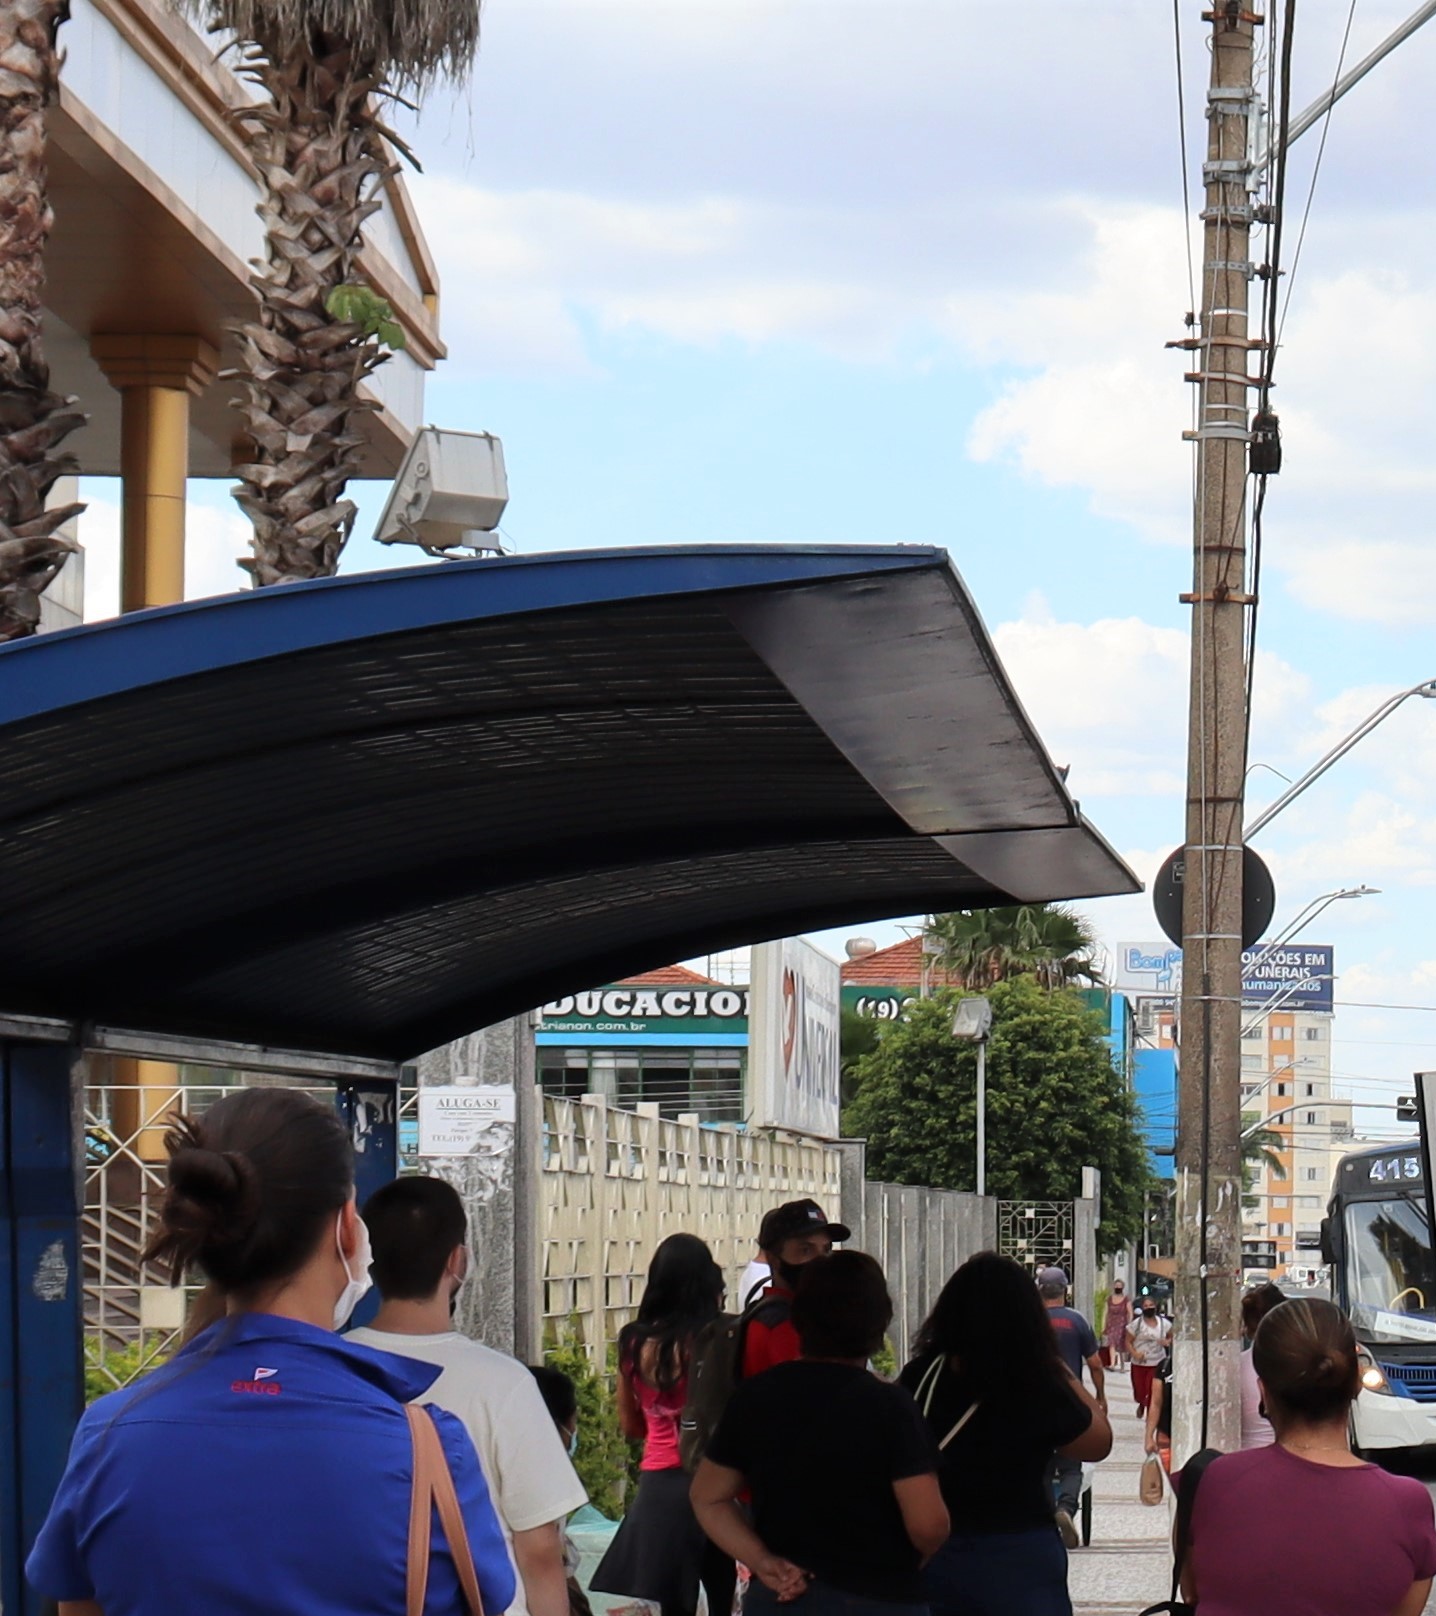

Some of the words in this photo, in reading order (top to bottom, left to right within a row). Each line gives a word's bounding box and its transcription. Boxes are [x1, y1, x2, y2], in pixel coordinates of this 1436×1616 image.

[1129, 948, 1164, 969] Bom
[1305, 953, 1326, 966] EM
[856, 996, 899, 1021] (19)
[437, 1098, 501, 1108] ALUGA-SE
[1369, 1156, 1420, 1181] 415
[231, 1379, 281, 1396] extra
